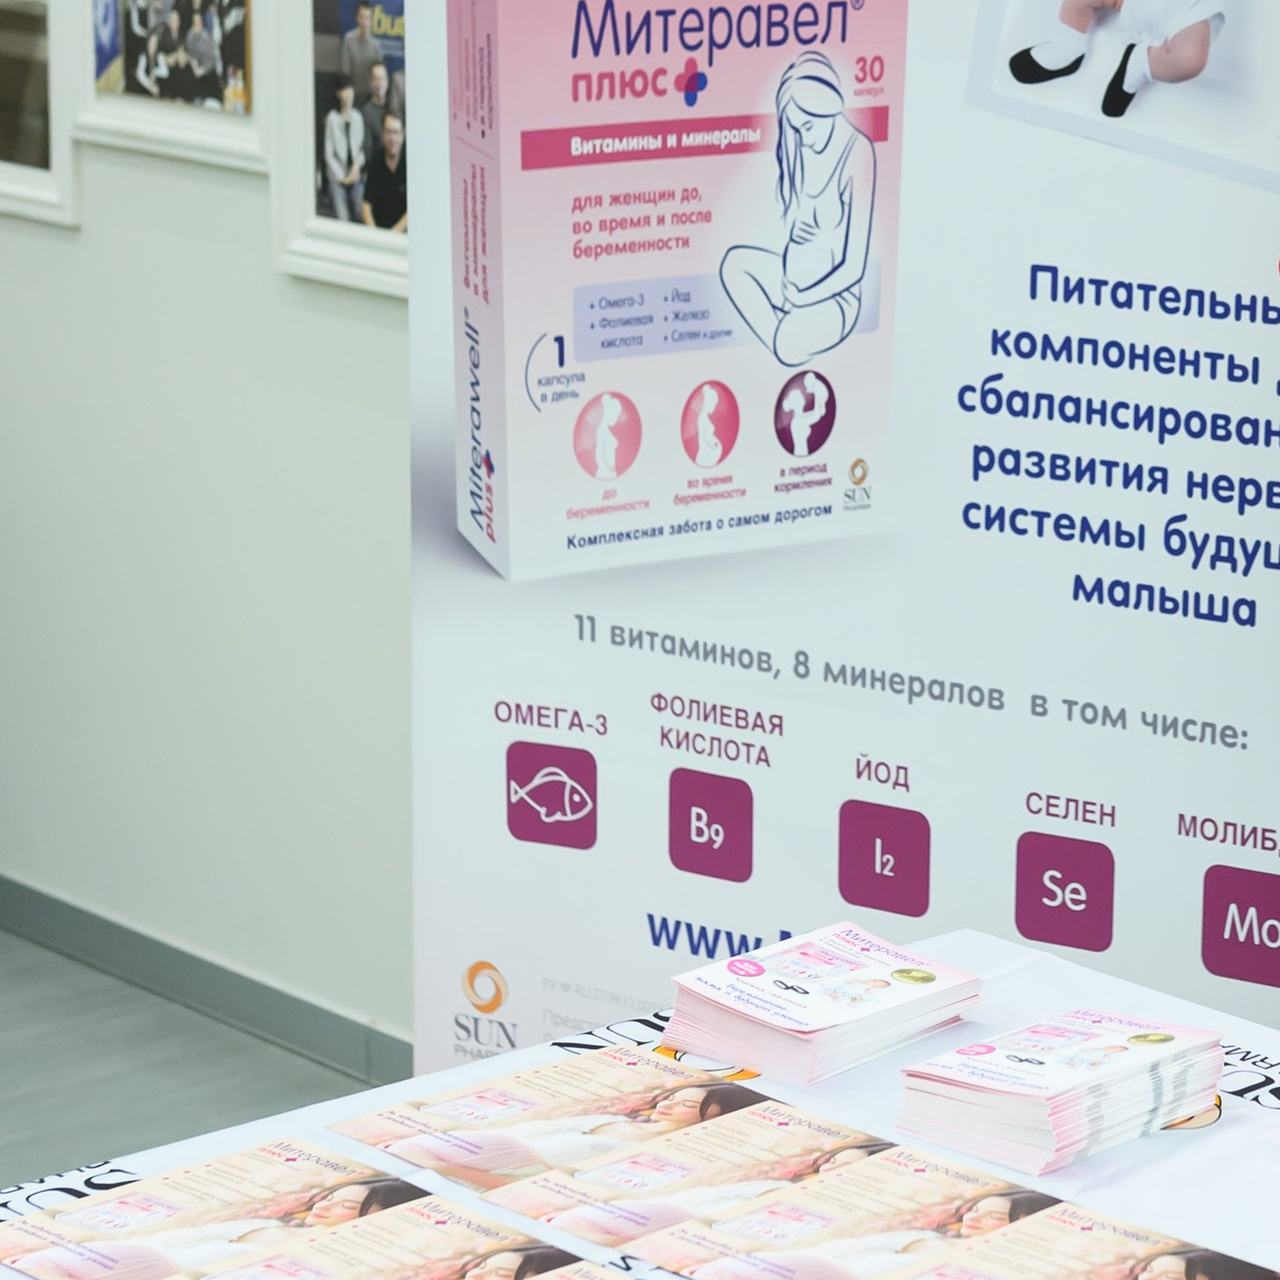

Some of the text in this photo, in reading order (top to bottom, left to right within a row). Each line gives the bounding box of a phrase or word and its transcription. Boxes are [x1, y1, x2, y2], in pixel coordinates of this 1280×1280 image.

[571, 67, 668, 102] плюс
[854, 55, 885, 84] 30
[570, 125, 761, 156] Витамины и минералы
[571, 185, 702, 214] для женщин до,
[572, 208, 712, 236] во время и после
[572, 235, 690, 260] беременности
[598, 293, 645, 310] Омега-3
[671, 288, 691, 303] Йод
[552, 335, 565, 368] 1
[991, 328, 1259, 384] компоненты
[536, 371, 586, 389] капсула
[540, 389, 580, 404] в день
[973, 444, 1169, 495] развития
[484, 473, 497, 544] plus
[566, 503, 833, 550] Комплексная забота о самом дорогом
[962, 501, 1146, 551] системы
[1073, 574, 1257, 627] малыша
[574, 614, 1249, 750] 11 витаминов, 8 минералов в том числе:
[494, 700, 608, 736] ОМЕГА-3
[650, 692, 784, 737] ФОЛИЕВАЯ
[659, 725, 771, 768] КИСЛОТА
[855, 753, 911, 793] ЙОД
[1025, 791, 1117, 828] СЕЛЕН
[1041, 869, 1088, 912] Se
[453, 1013, 519, 1049] SUN
